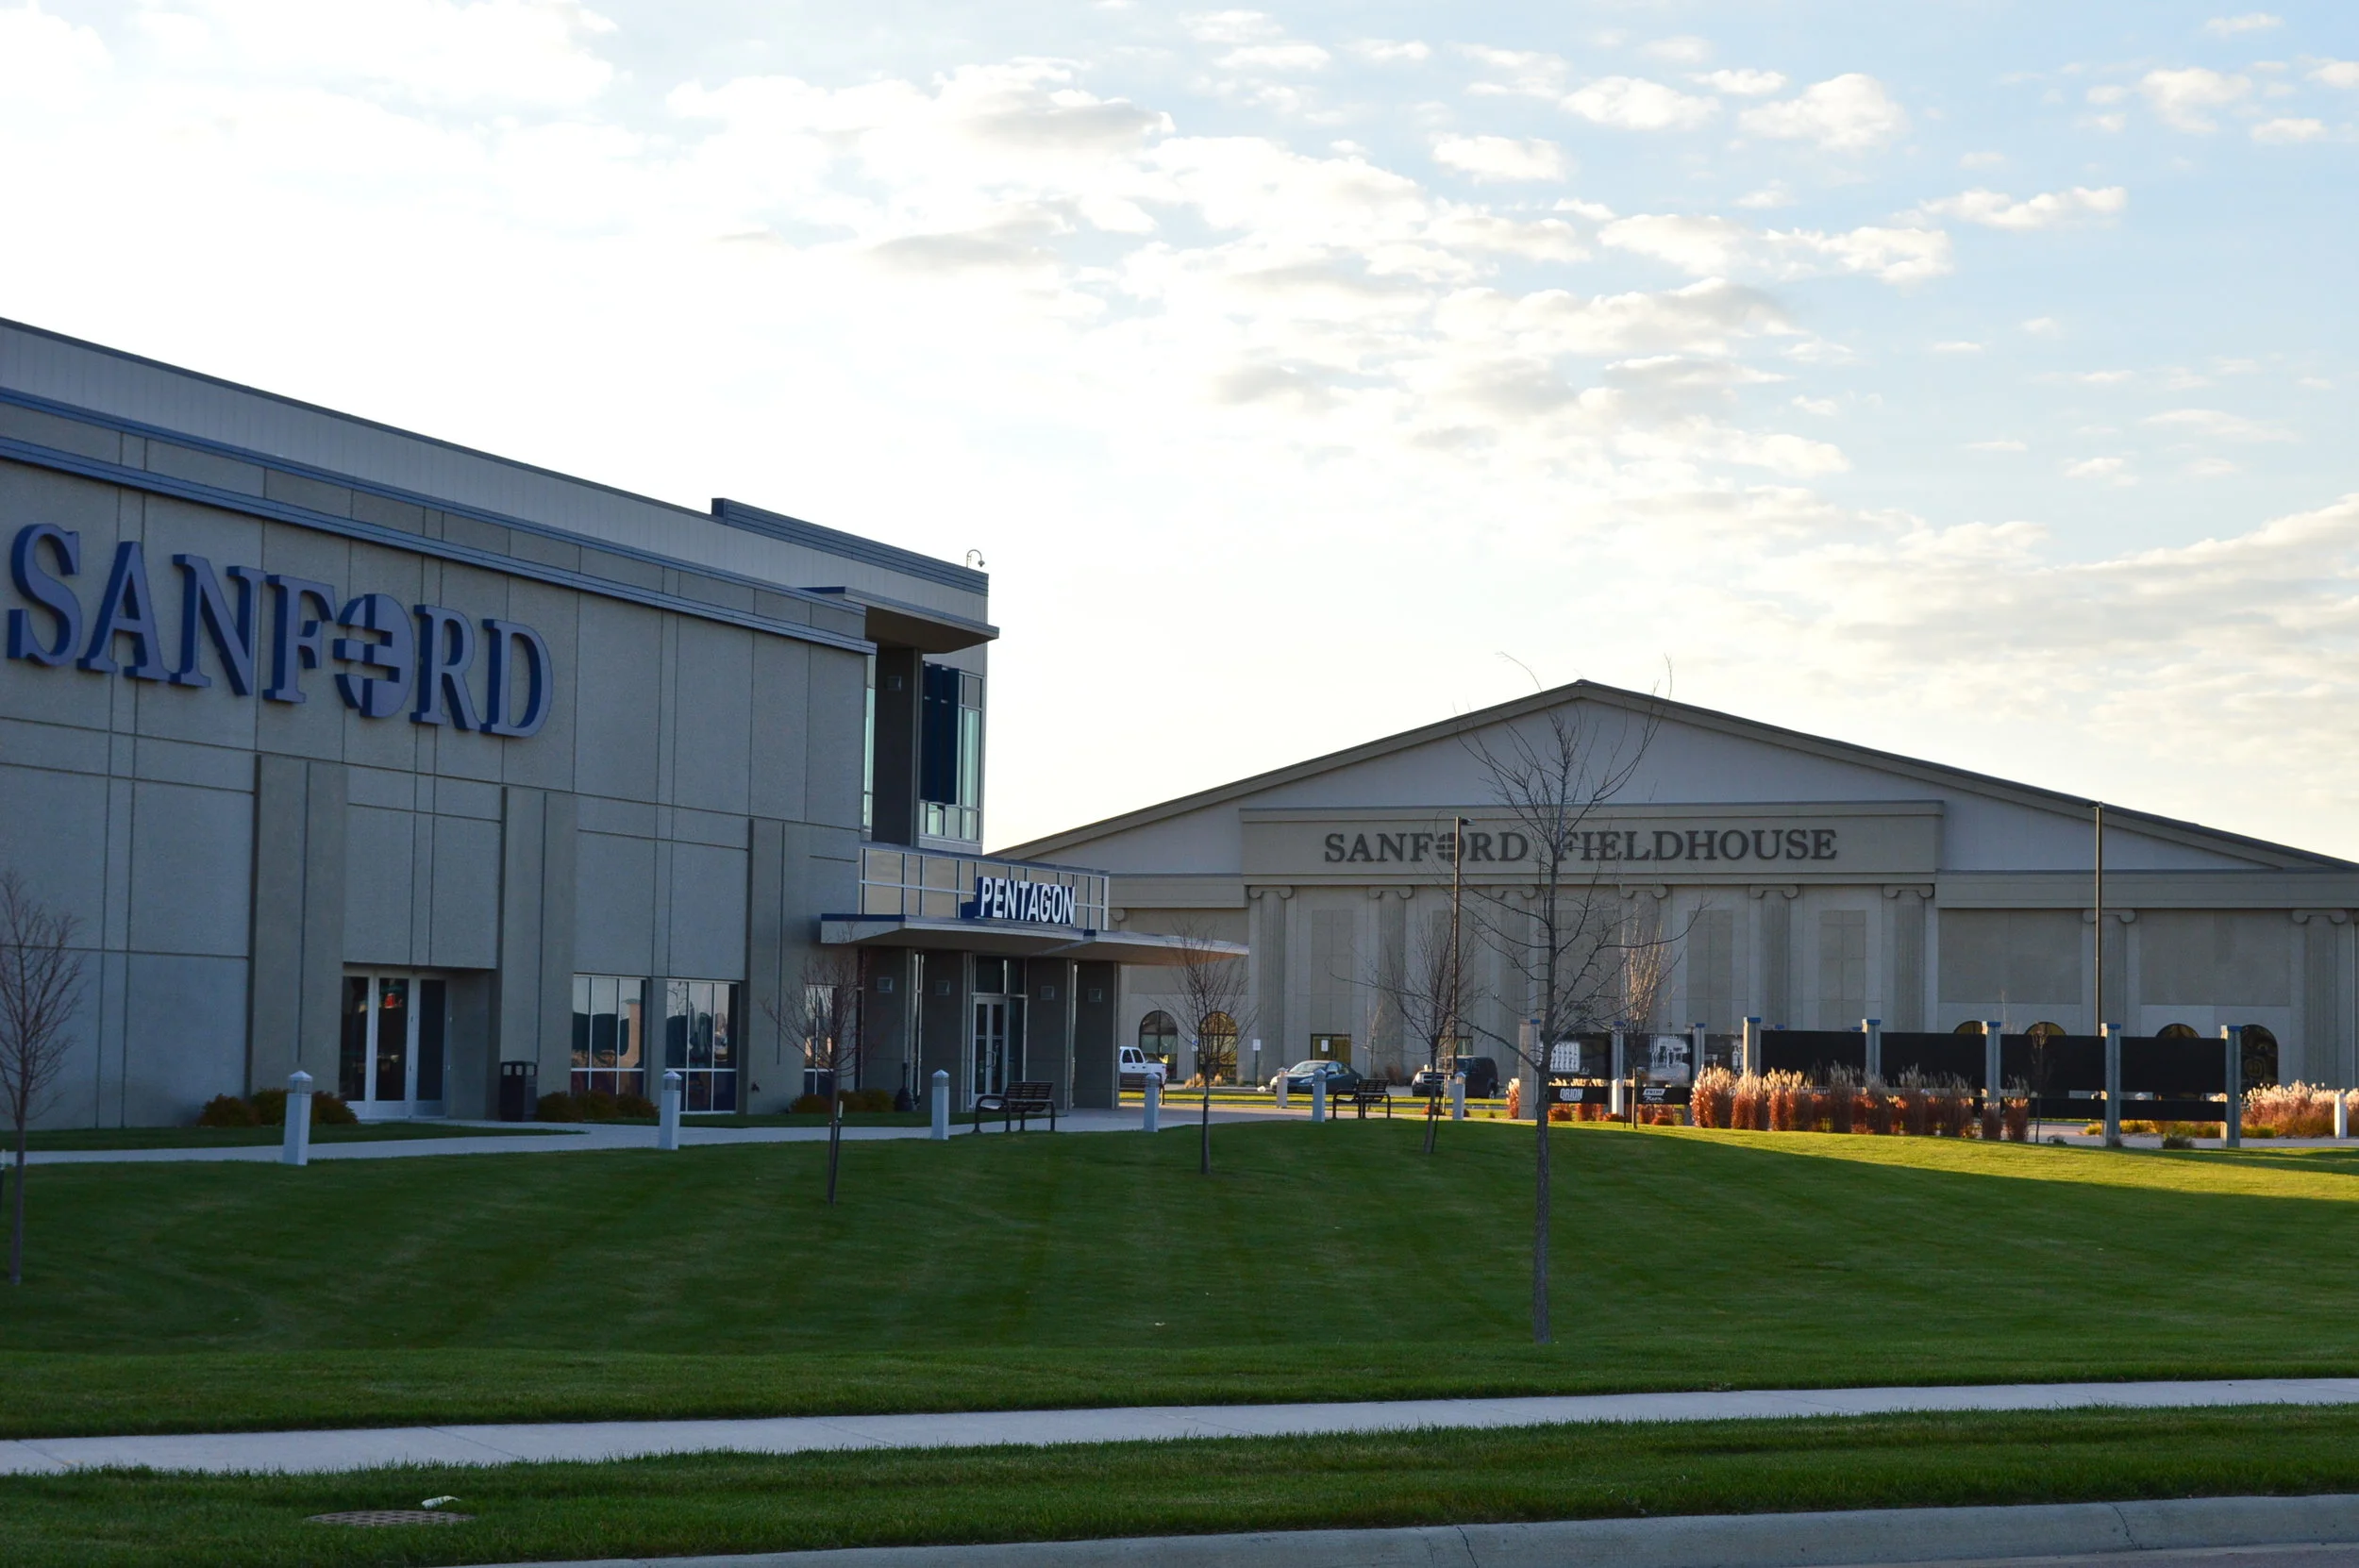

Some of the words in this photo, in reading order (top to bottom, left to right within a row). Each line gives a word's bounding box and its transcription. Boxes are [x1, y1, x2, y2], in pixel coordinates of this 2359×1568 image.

[8, 523, 553, 738] SANFORD
[1325, 832, 1529, 862] SANFORD
[1558, 829, 1837, 860] FIELDHOUSE
[979, 876, 1076, 925] PENTAGON
[1560, 1088, 1583, 1100] ORION
